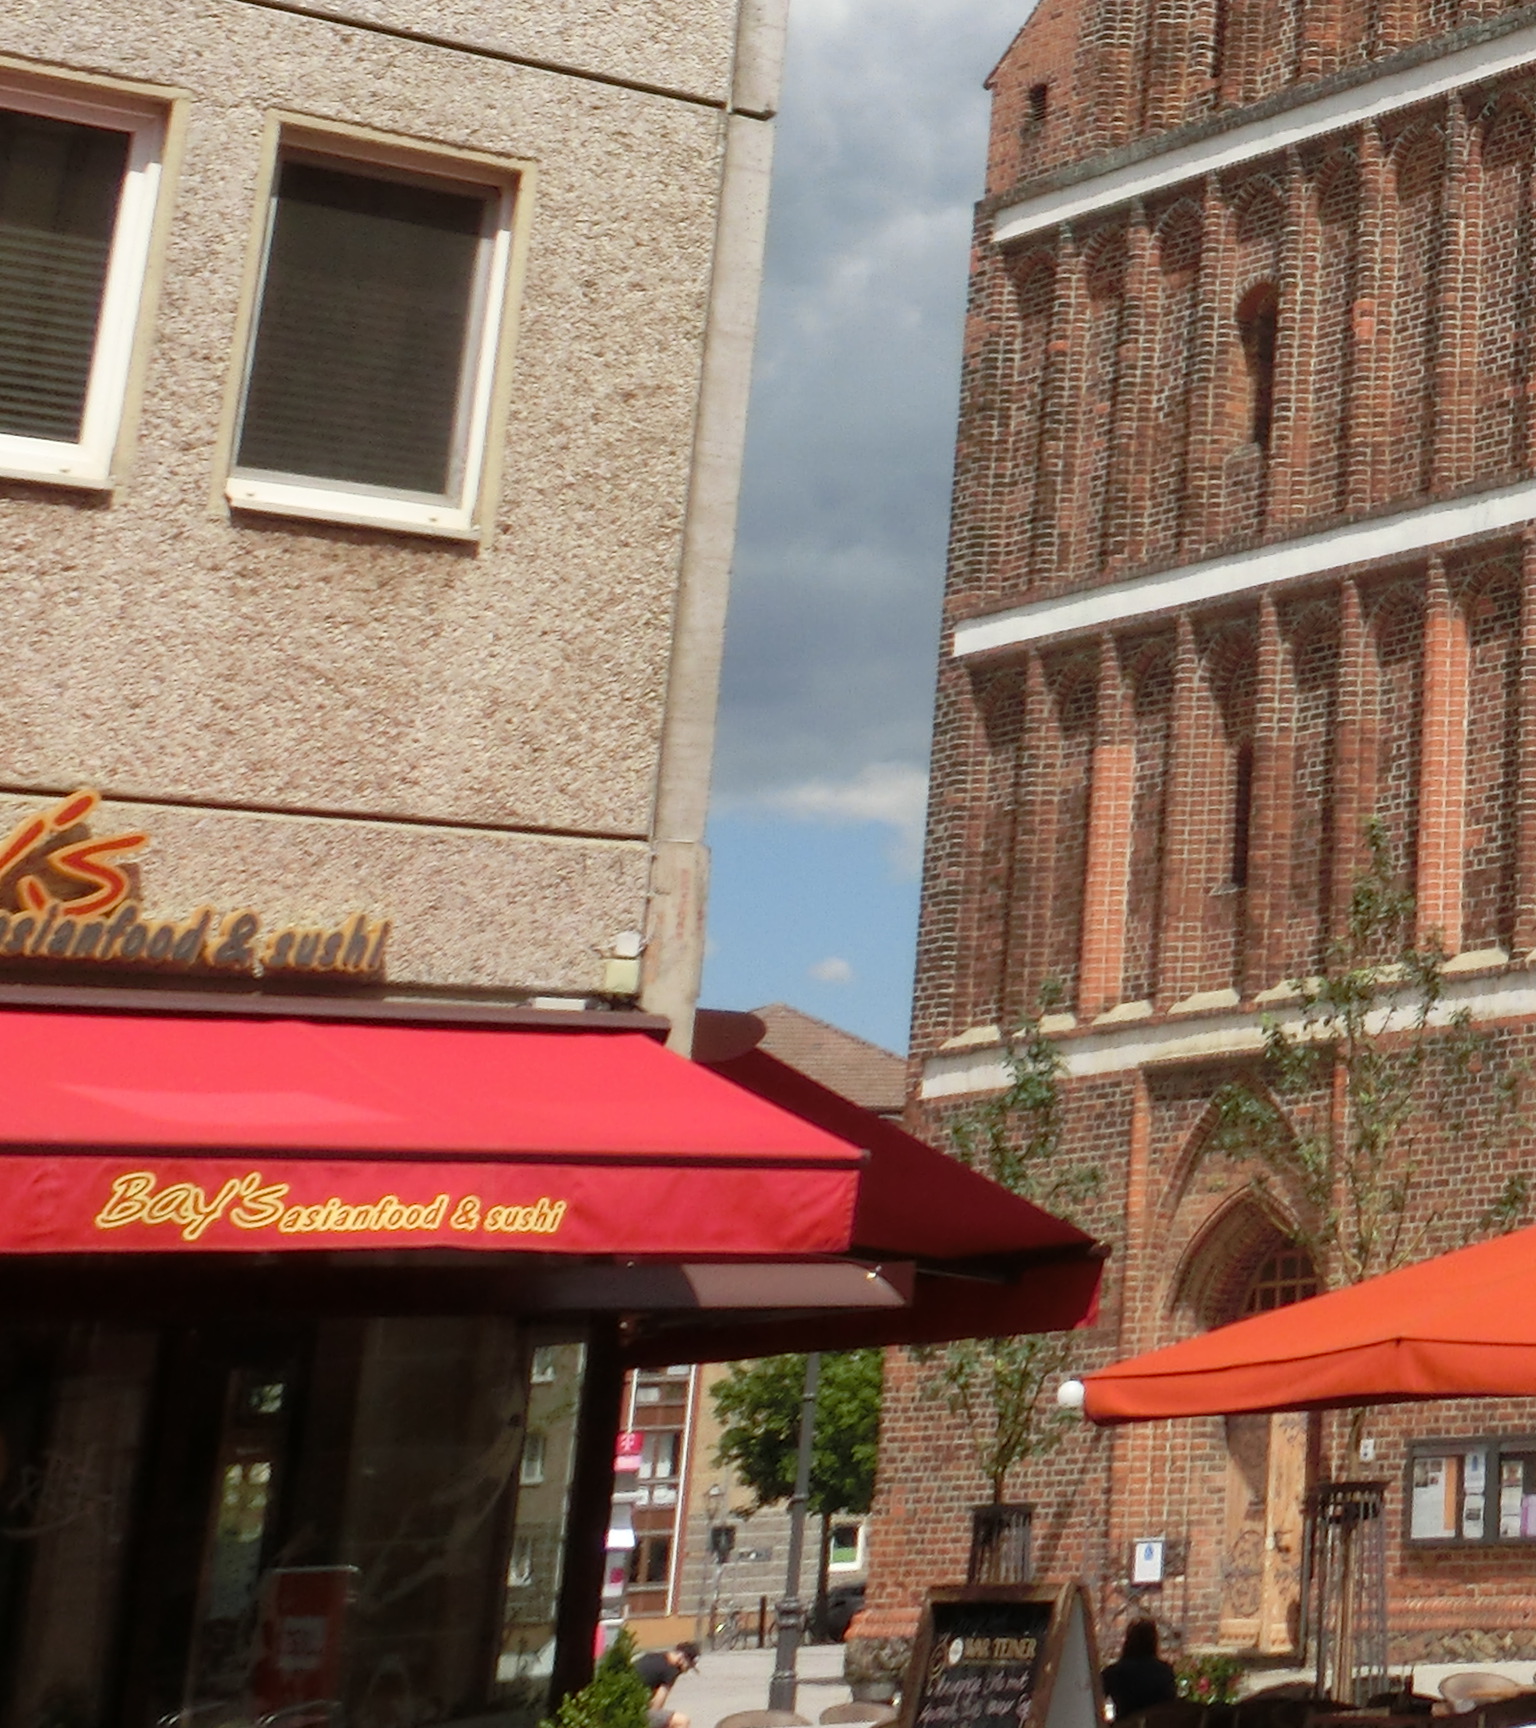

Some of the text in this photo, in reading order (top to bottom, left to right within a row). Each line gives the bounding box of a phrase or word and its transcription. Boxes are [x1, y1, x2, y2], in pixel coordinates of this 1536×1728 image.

[205, 908, 262, 969] &
[264, 912, 393, 972] sushi
[96, 1172, 567, 1240] Bay's asianfood & sushi
